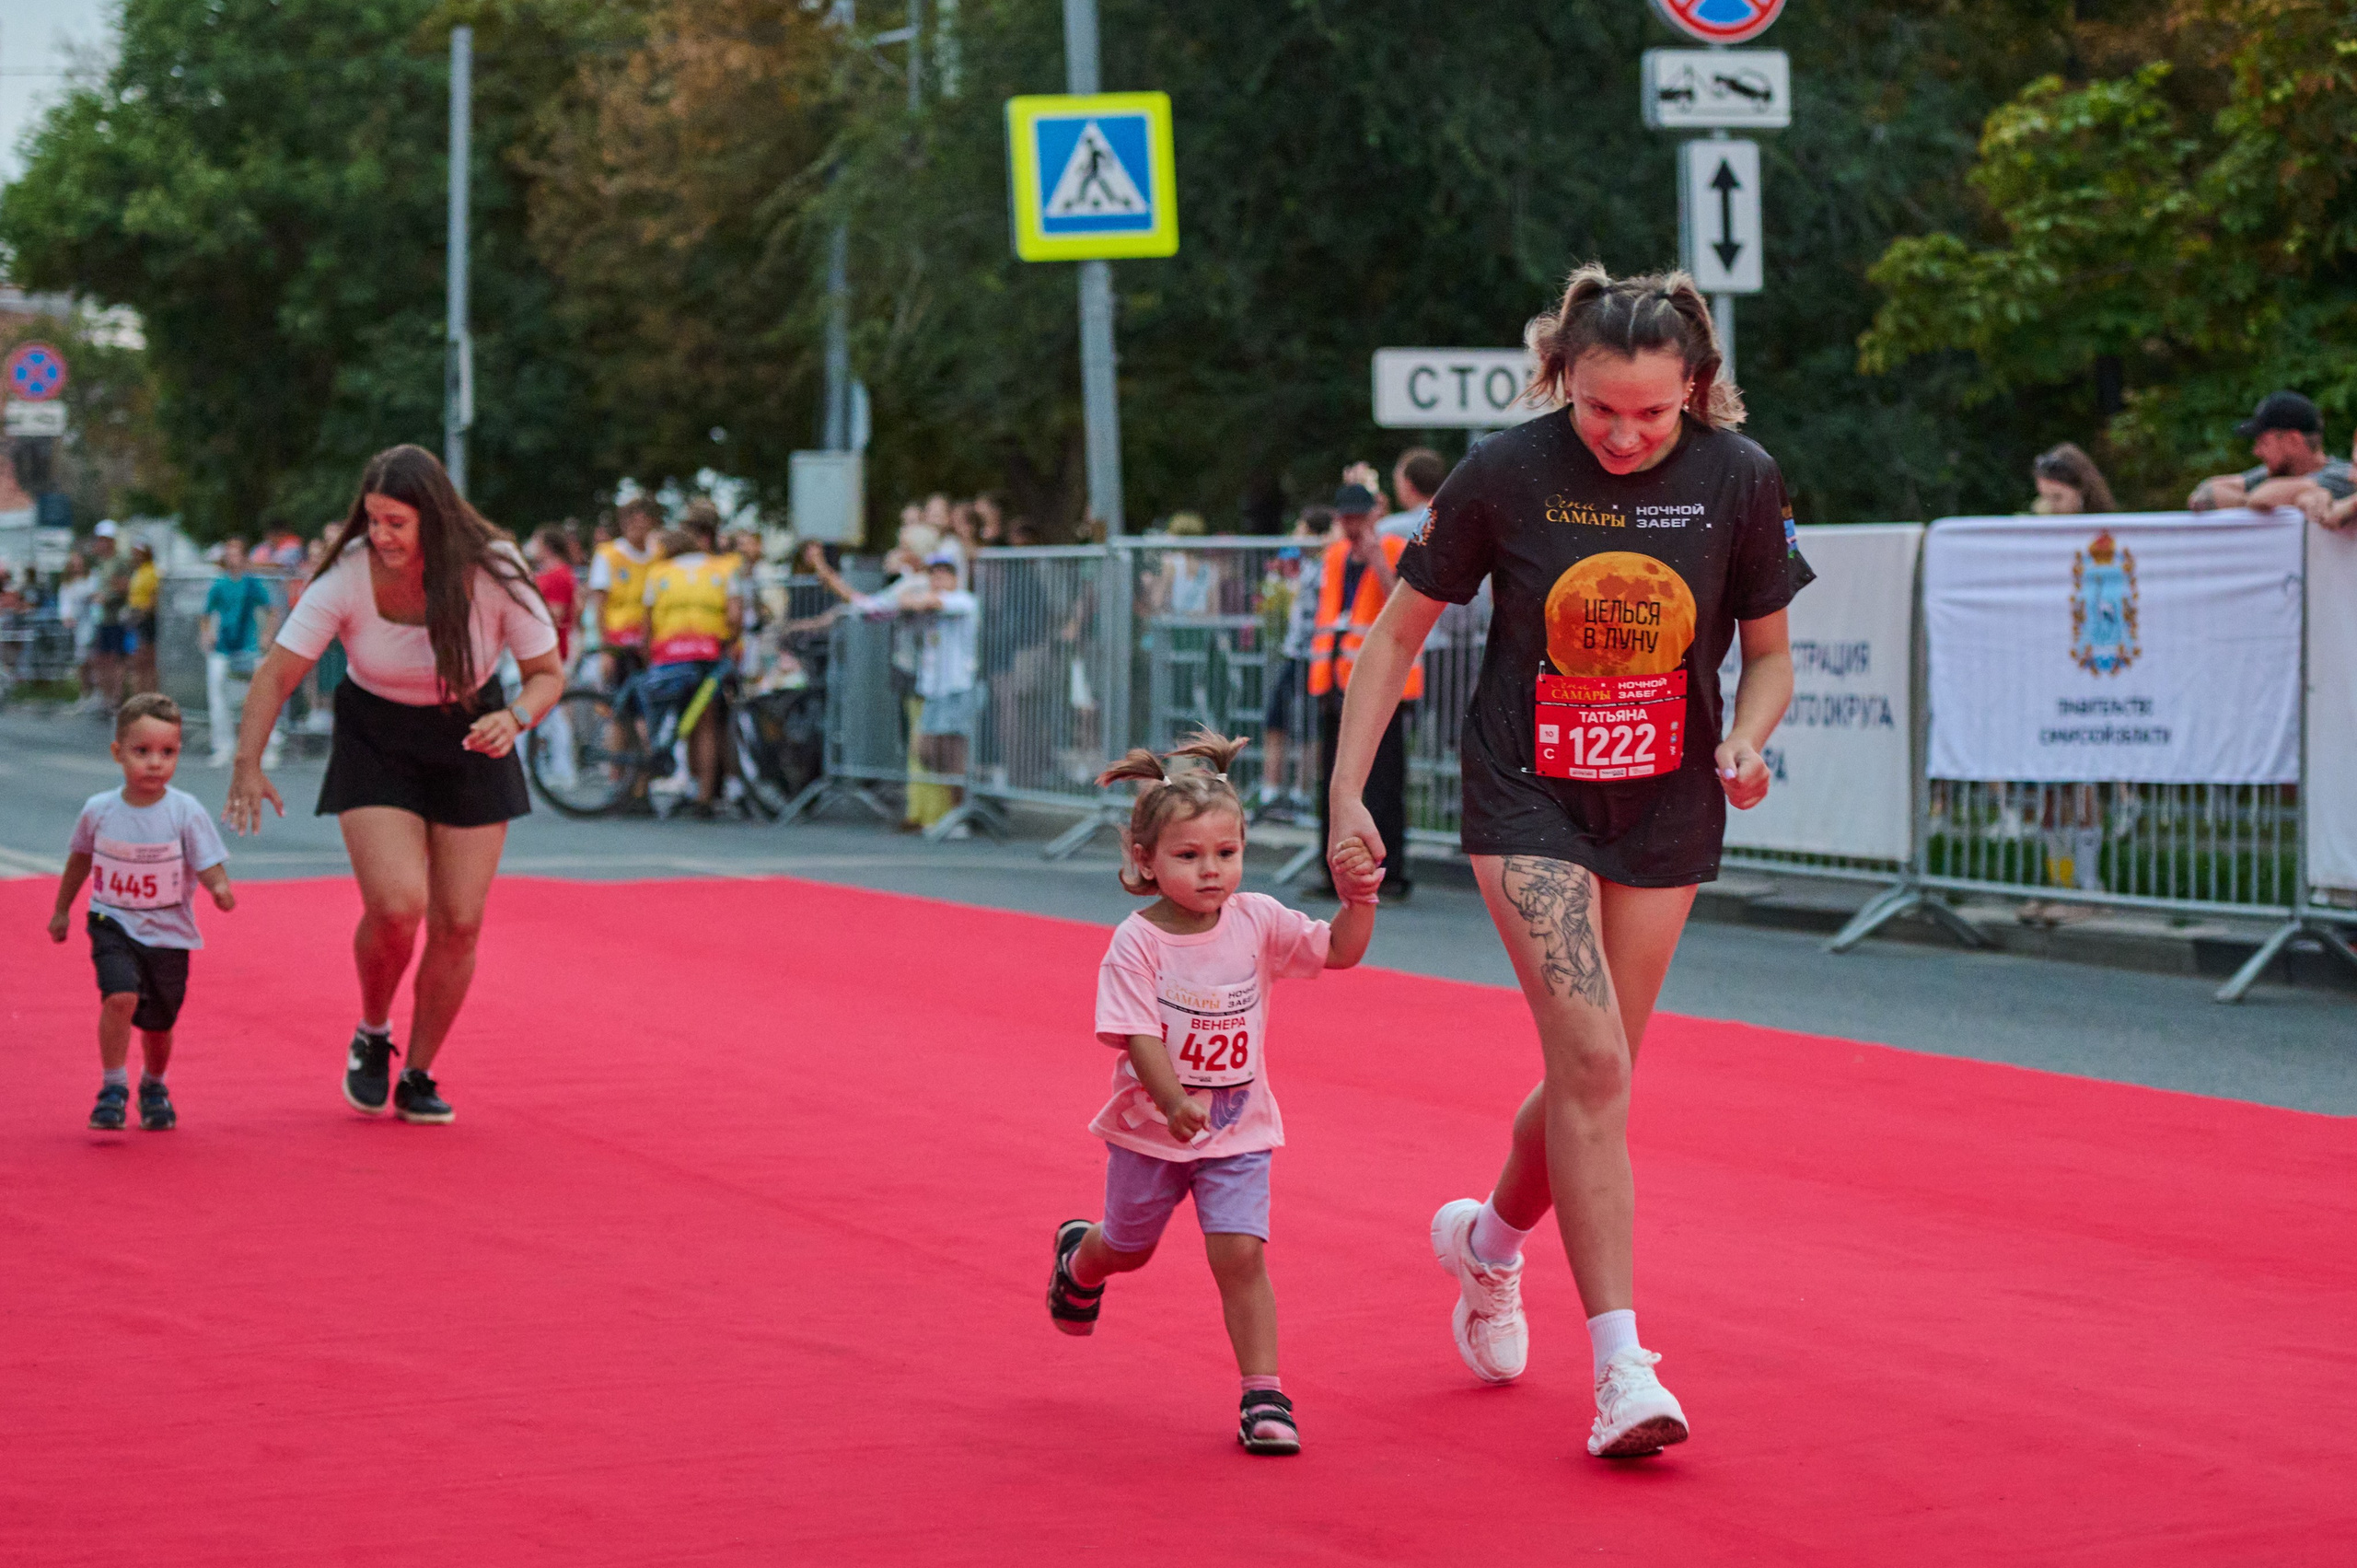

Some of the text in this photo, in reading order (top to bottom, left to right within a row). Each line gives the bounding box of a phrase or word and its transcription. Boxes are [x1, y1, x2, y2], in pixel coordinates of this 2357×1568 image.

[1546, 509, 1626, 528] САМАРЫ
[1636, 504, 1705, 516] НОЧНОЙ
[1636, 518, 1690, 528] ЗАБЕГ
[1585, 598, 1661, 626] ЦЕЛЬСЯ
[1584, 627, 1659, 654] В ЛУНУ
[1618, 678, 1667, 689] НОЧНОЙ
[1551, 689, 1611, 701] САМАРЫ
[1618, 690, 1657, 699] ЗАБЕГ
[1579, 709, 1648, 723] ТАТЬЯНА
[1569, 723, 1656, 765] 1222
[109, 870, 157, 899] 445
[1165, 988, 1220, 1010] САМАРЫ
[1228, 982, 1256, 999] НОЧНО
[1190, 1016, 1246, 1030] ВЕНЕРА
[1179, 1030, 1248, 1072] 428
